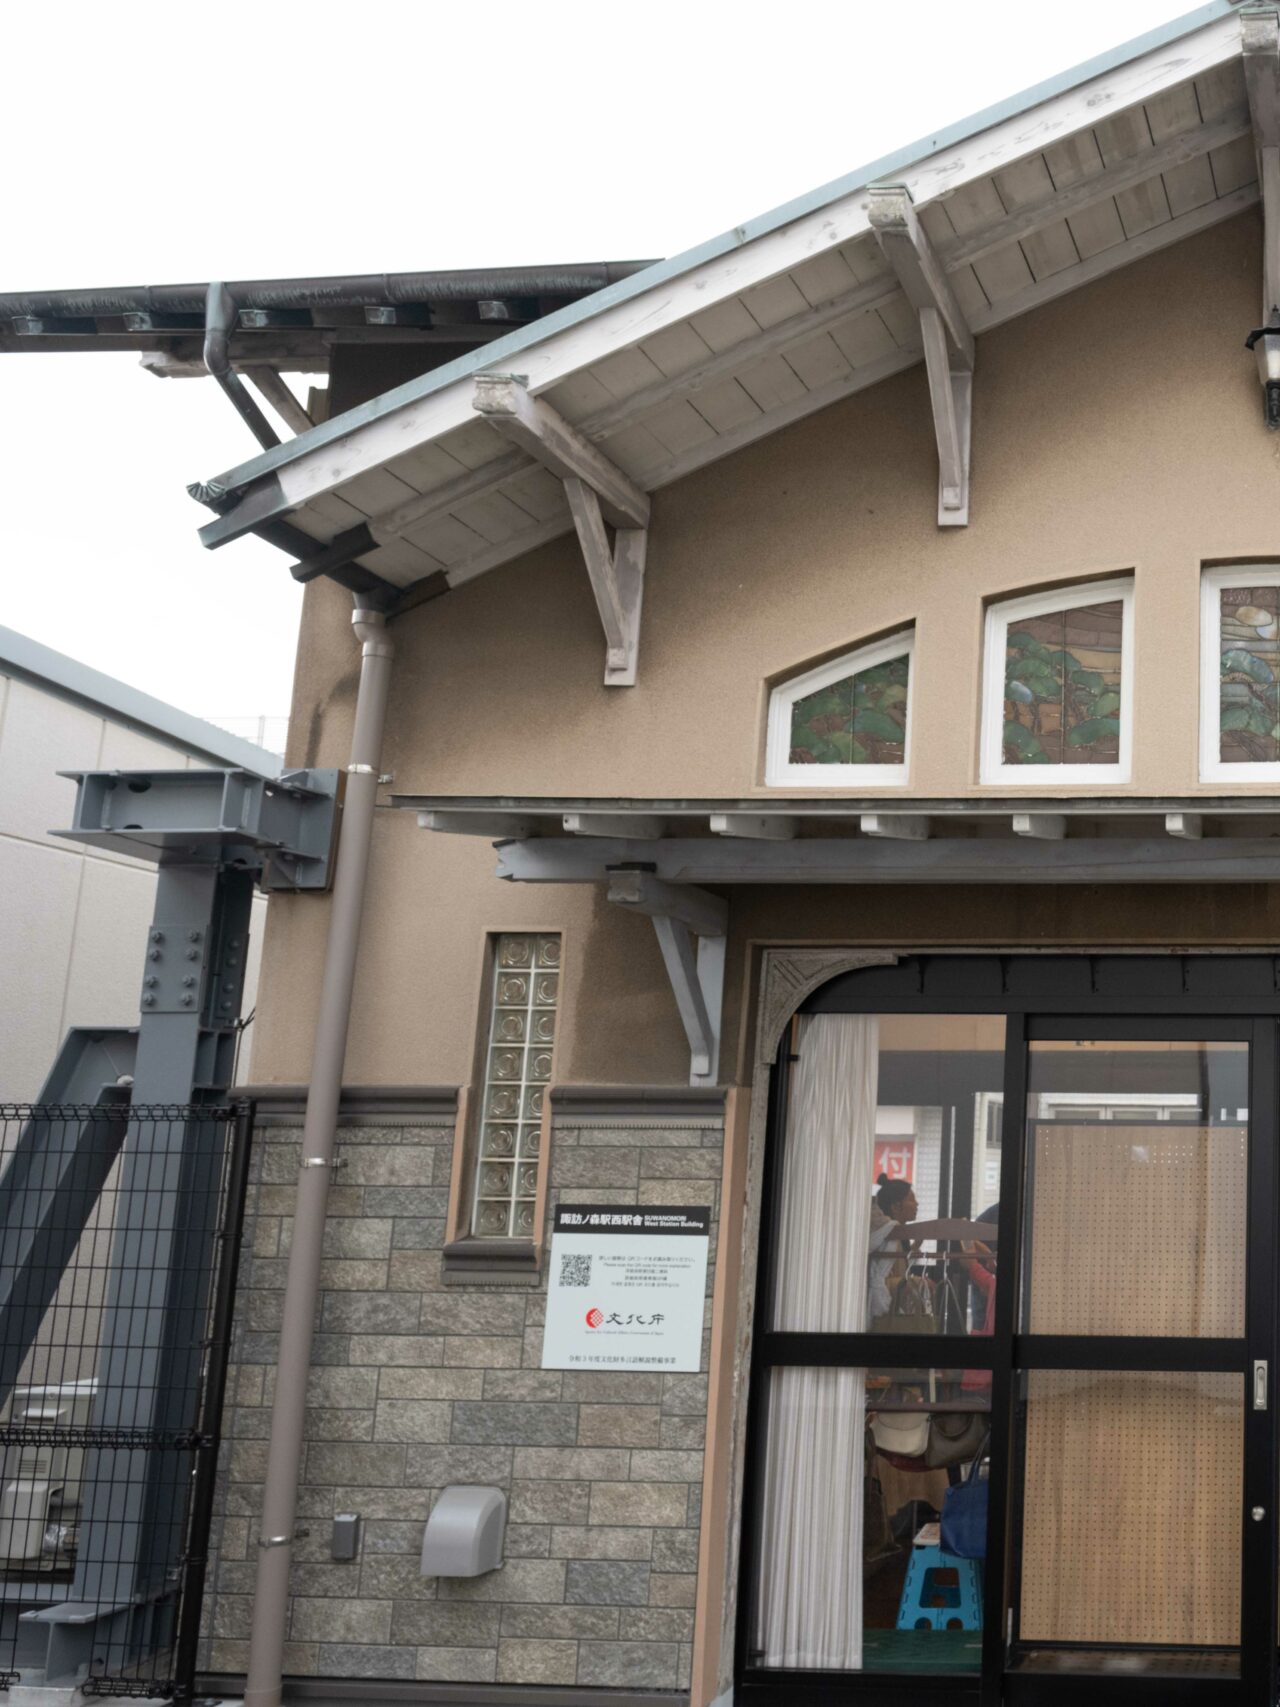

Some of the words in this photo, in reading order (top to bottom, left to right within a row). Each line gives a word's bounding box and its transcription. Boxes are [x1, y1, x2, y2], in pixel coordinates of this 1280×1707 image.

[560, 1213, 643, 1227] 諏訪ノ森駅西駅舎
[680, 1221, 704, 1229] Building
[605, 1312, 665, 1326] 文化庁
